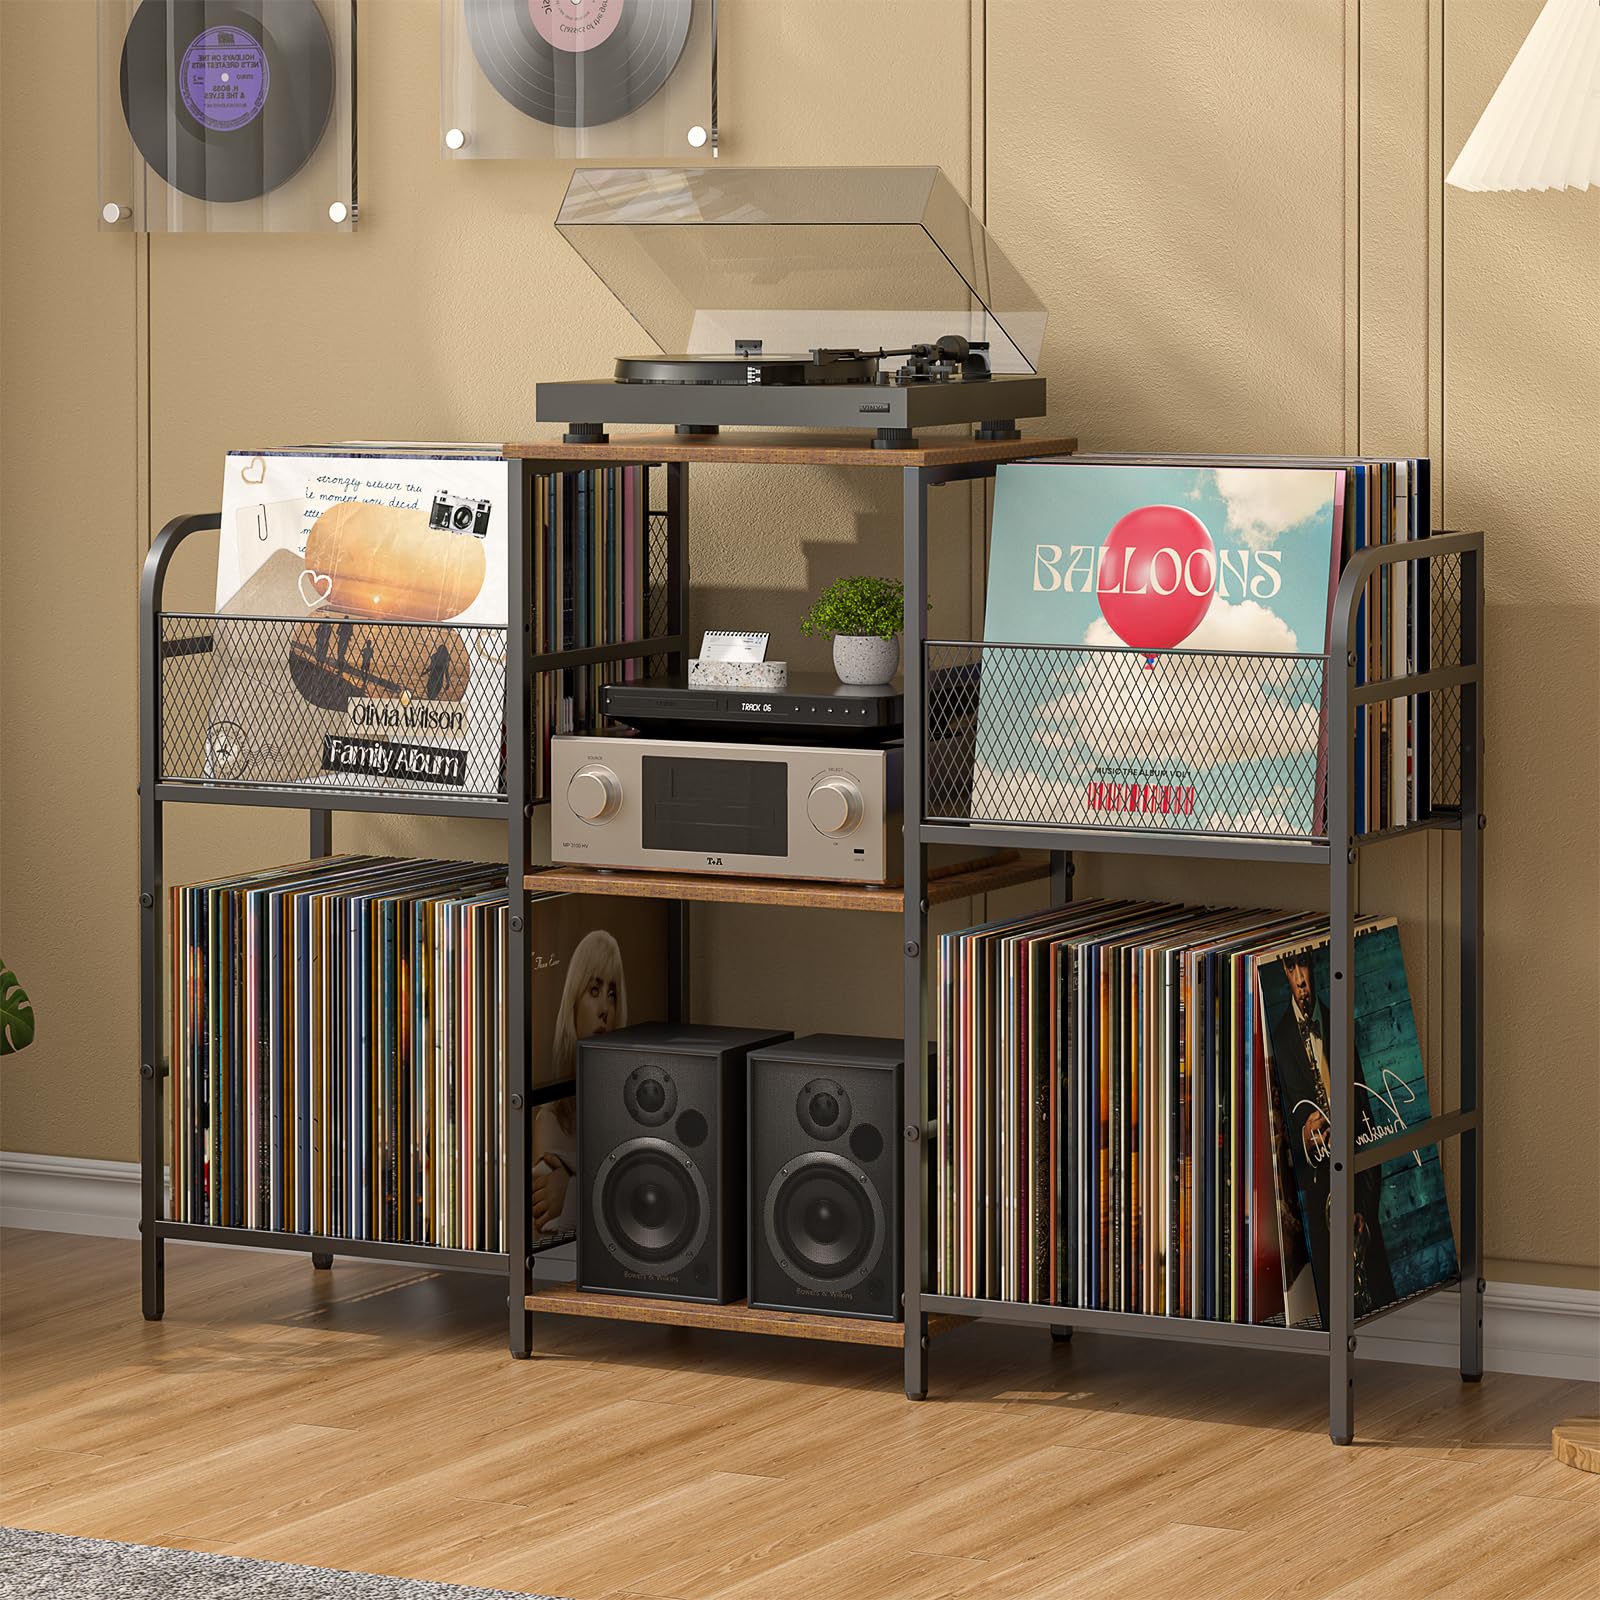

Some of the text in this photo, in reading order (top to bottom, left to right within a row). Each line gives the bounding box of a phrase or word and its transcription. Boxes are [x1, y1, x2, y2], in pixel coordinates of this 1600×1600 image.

[316, 475, 361, 492] strongly
[1033, 544, 1282, 599] BALLOONS
[352, 704, 463, 730] Olivia Wilson
[741, 702, 762, 712] TRACK
[329, 739, 459, 778] Family Album
